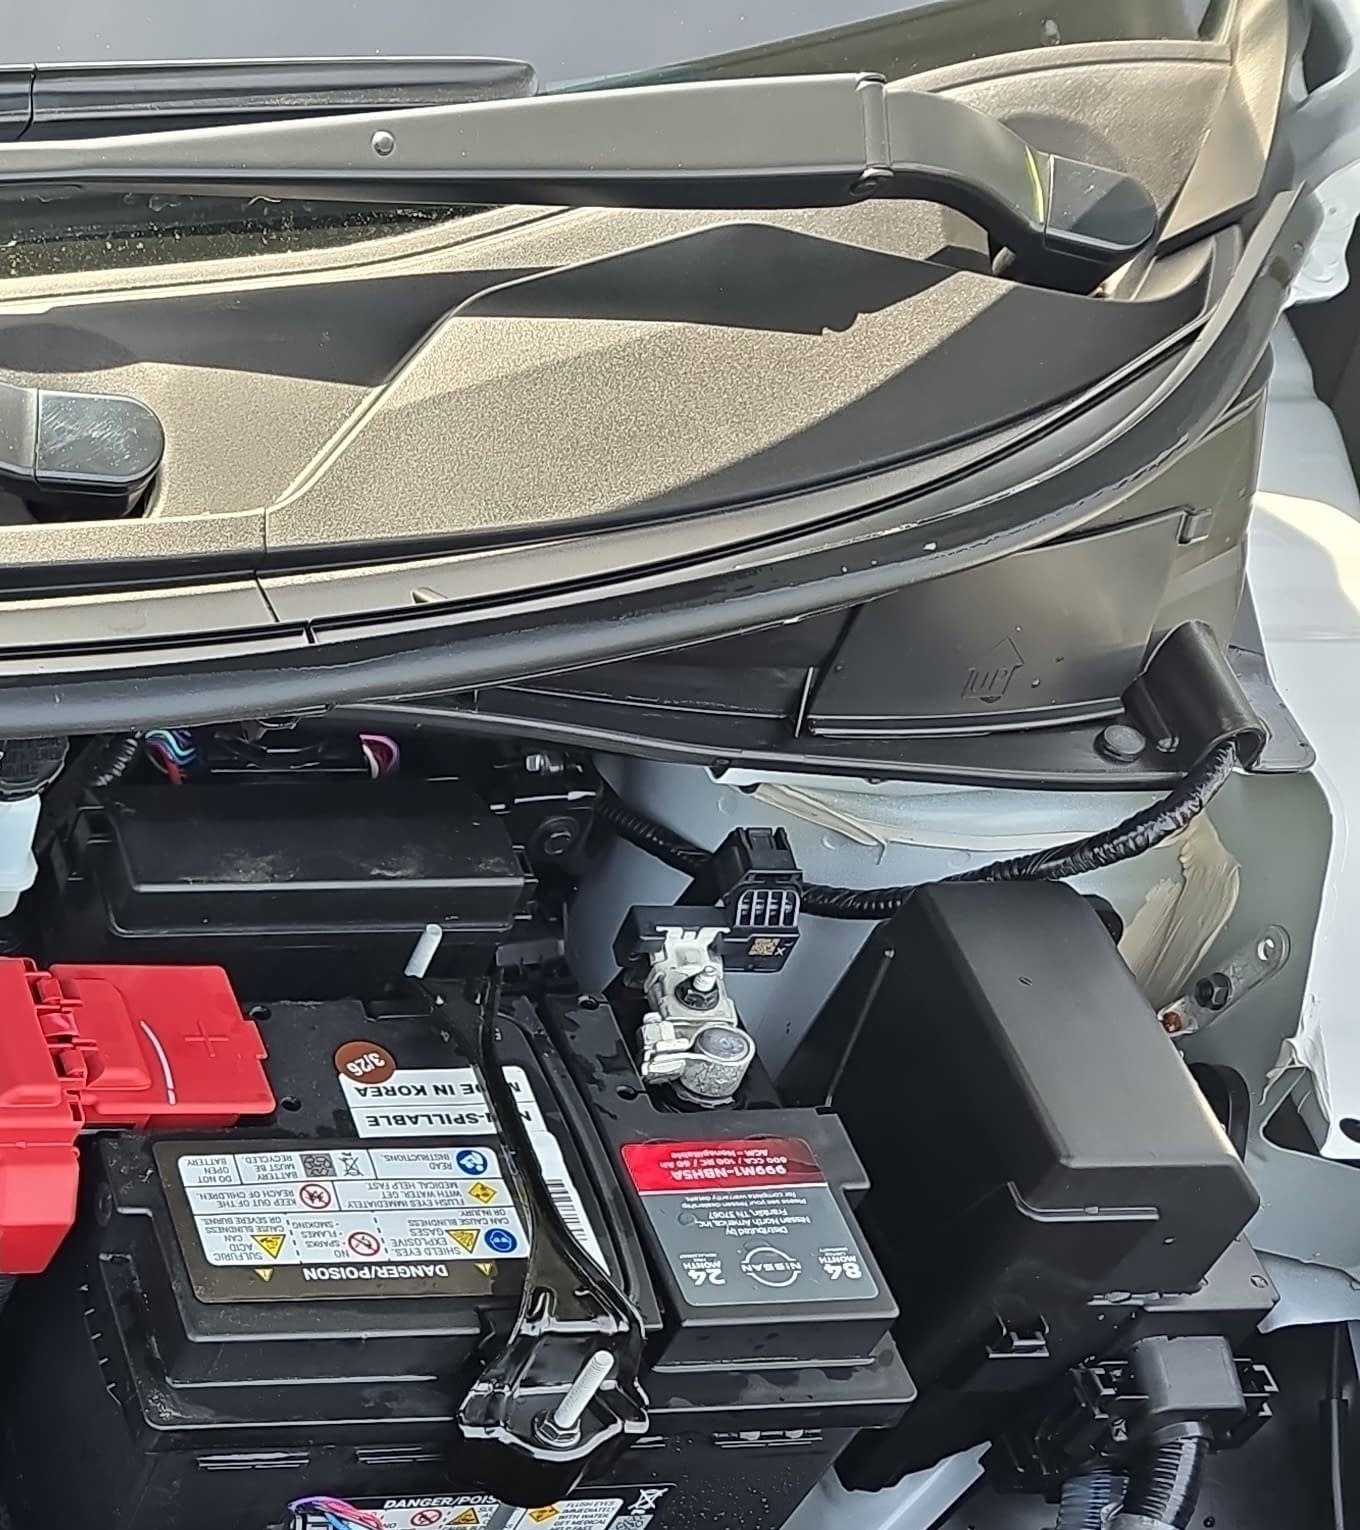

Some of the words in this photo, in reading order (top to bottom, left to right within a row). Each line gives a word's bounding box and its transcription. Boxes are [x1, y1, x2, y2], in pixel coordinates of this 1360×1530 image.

[346, 1052, 385, 1076] 3/26
[354, 1085, 427, 1097] KOREA
[431, 1084, 453, 1095] IN
[670, 1149, 736, 1159] Nonspillable
[743, 1149, 768, 1157] AGM
[716, 1157, 736, 1165] 100
[268, 1163, 295, 1171] MUST
[428, 1162, 453, 1170] READ
[256, 1171, 297, 1180] BATTERY
[670, 1165, 787, 1180] 999M1-NBH5A
[218, 1175, 232, 1183] DO
[391, 1182, 416, 1191] HELP
[418, 1181, 458, 1190] MEDICAL
[262, 1190, 294, 1198] REACH
[382, 1191, 400, 1199] GET
[437, 1190, 461, 1198] WITH
[216, 1200, 235, 1208] THE
[252, 1199, 271, 1207] OUT
[273, 1198, 297, 1206] KEEP
[348, 1200, 408, 1209] IMMEDIATELY
[410, 1199, 433, 1207] EYES
[435, 1198, 465, 1207] FLUSH
[457, 1217, 488, 1226] CAUSE
[490, 1217, 509, 1225] CAN
[779, 1216, 811, 1224] Nissan
[292, 1221, 334, 1229] SMOKING
[301, 1230, 336, 1238] FLAMES
[410, 1228, 444, 1237] GASES
[725, 1226, 738, 1236] by
[738, 1226, 789, 1235] Distributed
[305, 1239, 341, 1248] SPARKS
[391, 1237, 446, 1247] EXPLOSIVE
[334, 1249, 349, 1258] NO
[423, 1246, 461, 1255] SHIELD
[213, 1252, 263, 1260] SULFURIC
[818, 1255, 856, 1264] MONTH
[682, 1261, 721, 1269] MONTH
[741, 1262, 801, 1272] NISSAN
[303, 1263, 449, 1280] DANGER/POISON
[823, 1263, 862, 1279] 84
[687, 1269, 726, 1286] 24
[384, 1495, 498, 1509] DANGER/POIS
